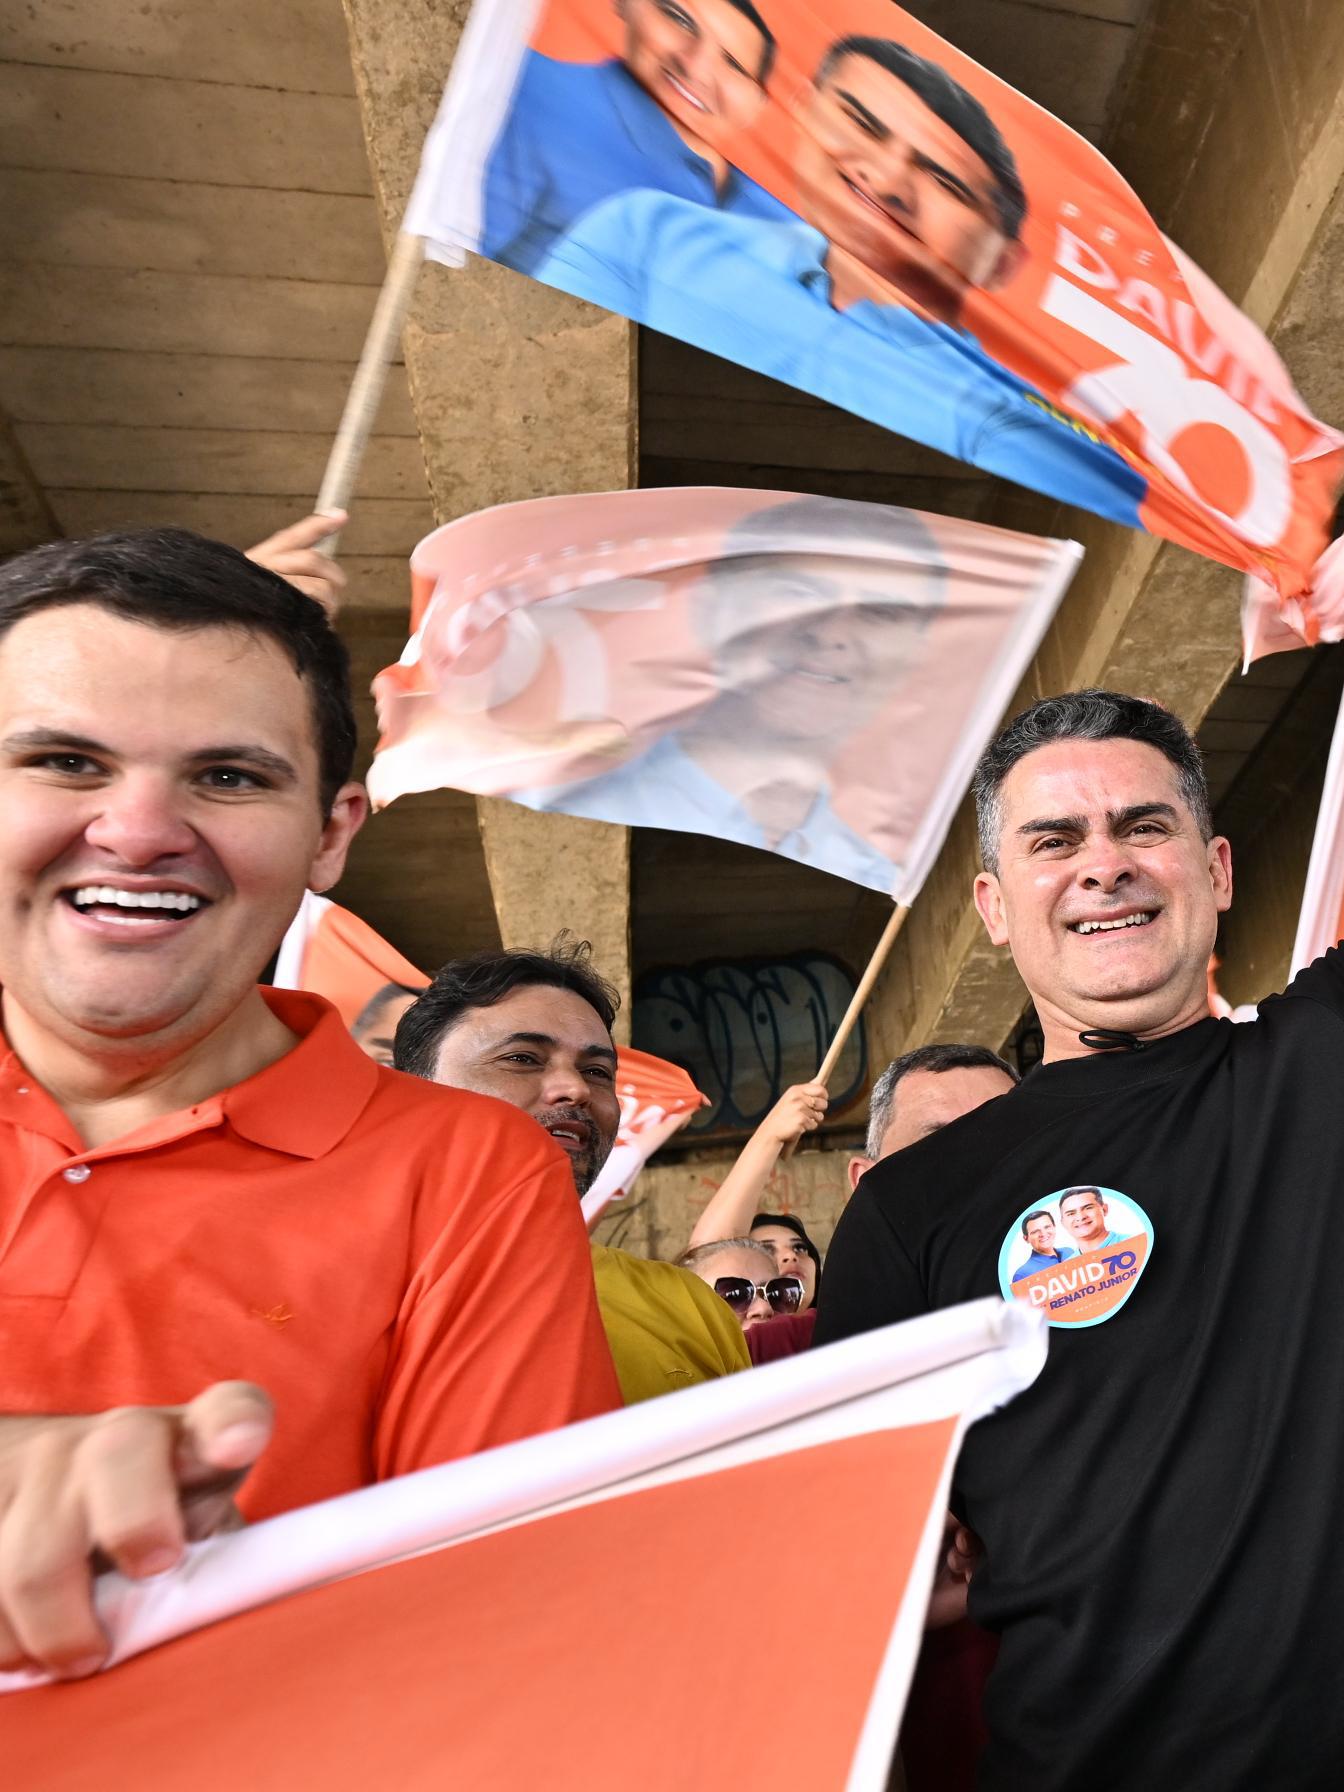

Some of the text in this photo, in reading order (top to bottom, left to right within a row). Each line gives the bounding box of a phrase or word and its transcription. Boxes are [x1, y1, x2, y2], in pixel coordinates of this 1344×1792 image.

[1029, 1262, 1105, 1306] DAVID
[1101, 1250, 1137, 1276] 70
[1049, 1285, 1096, 1310] RENATO
[1097, 1267, 1138, 1292] JUNIOR
